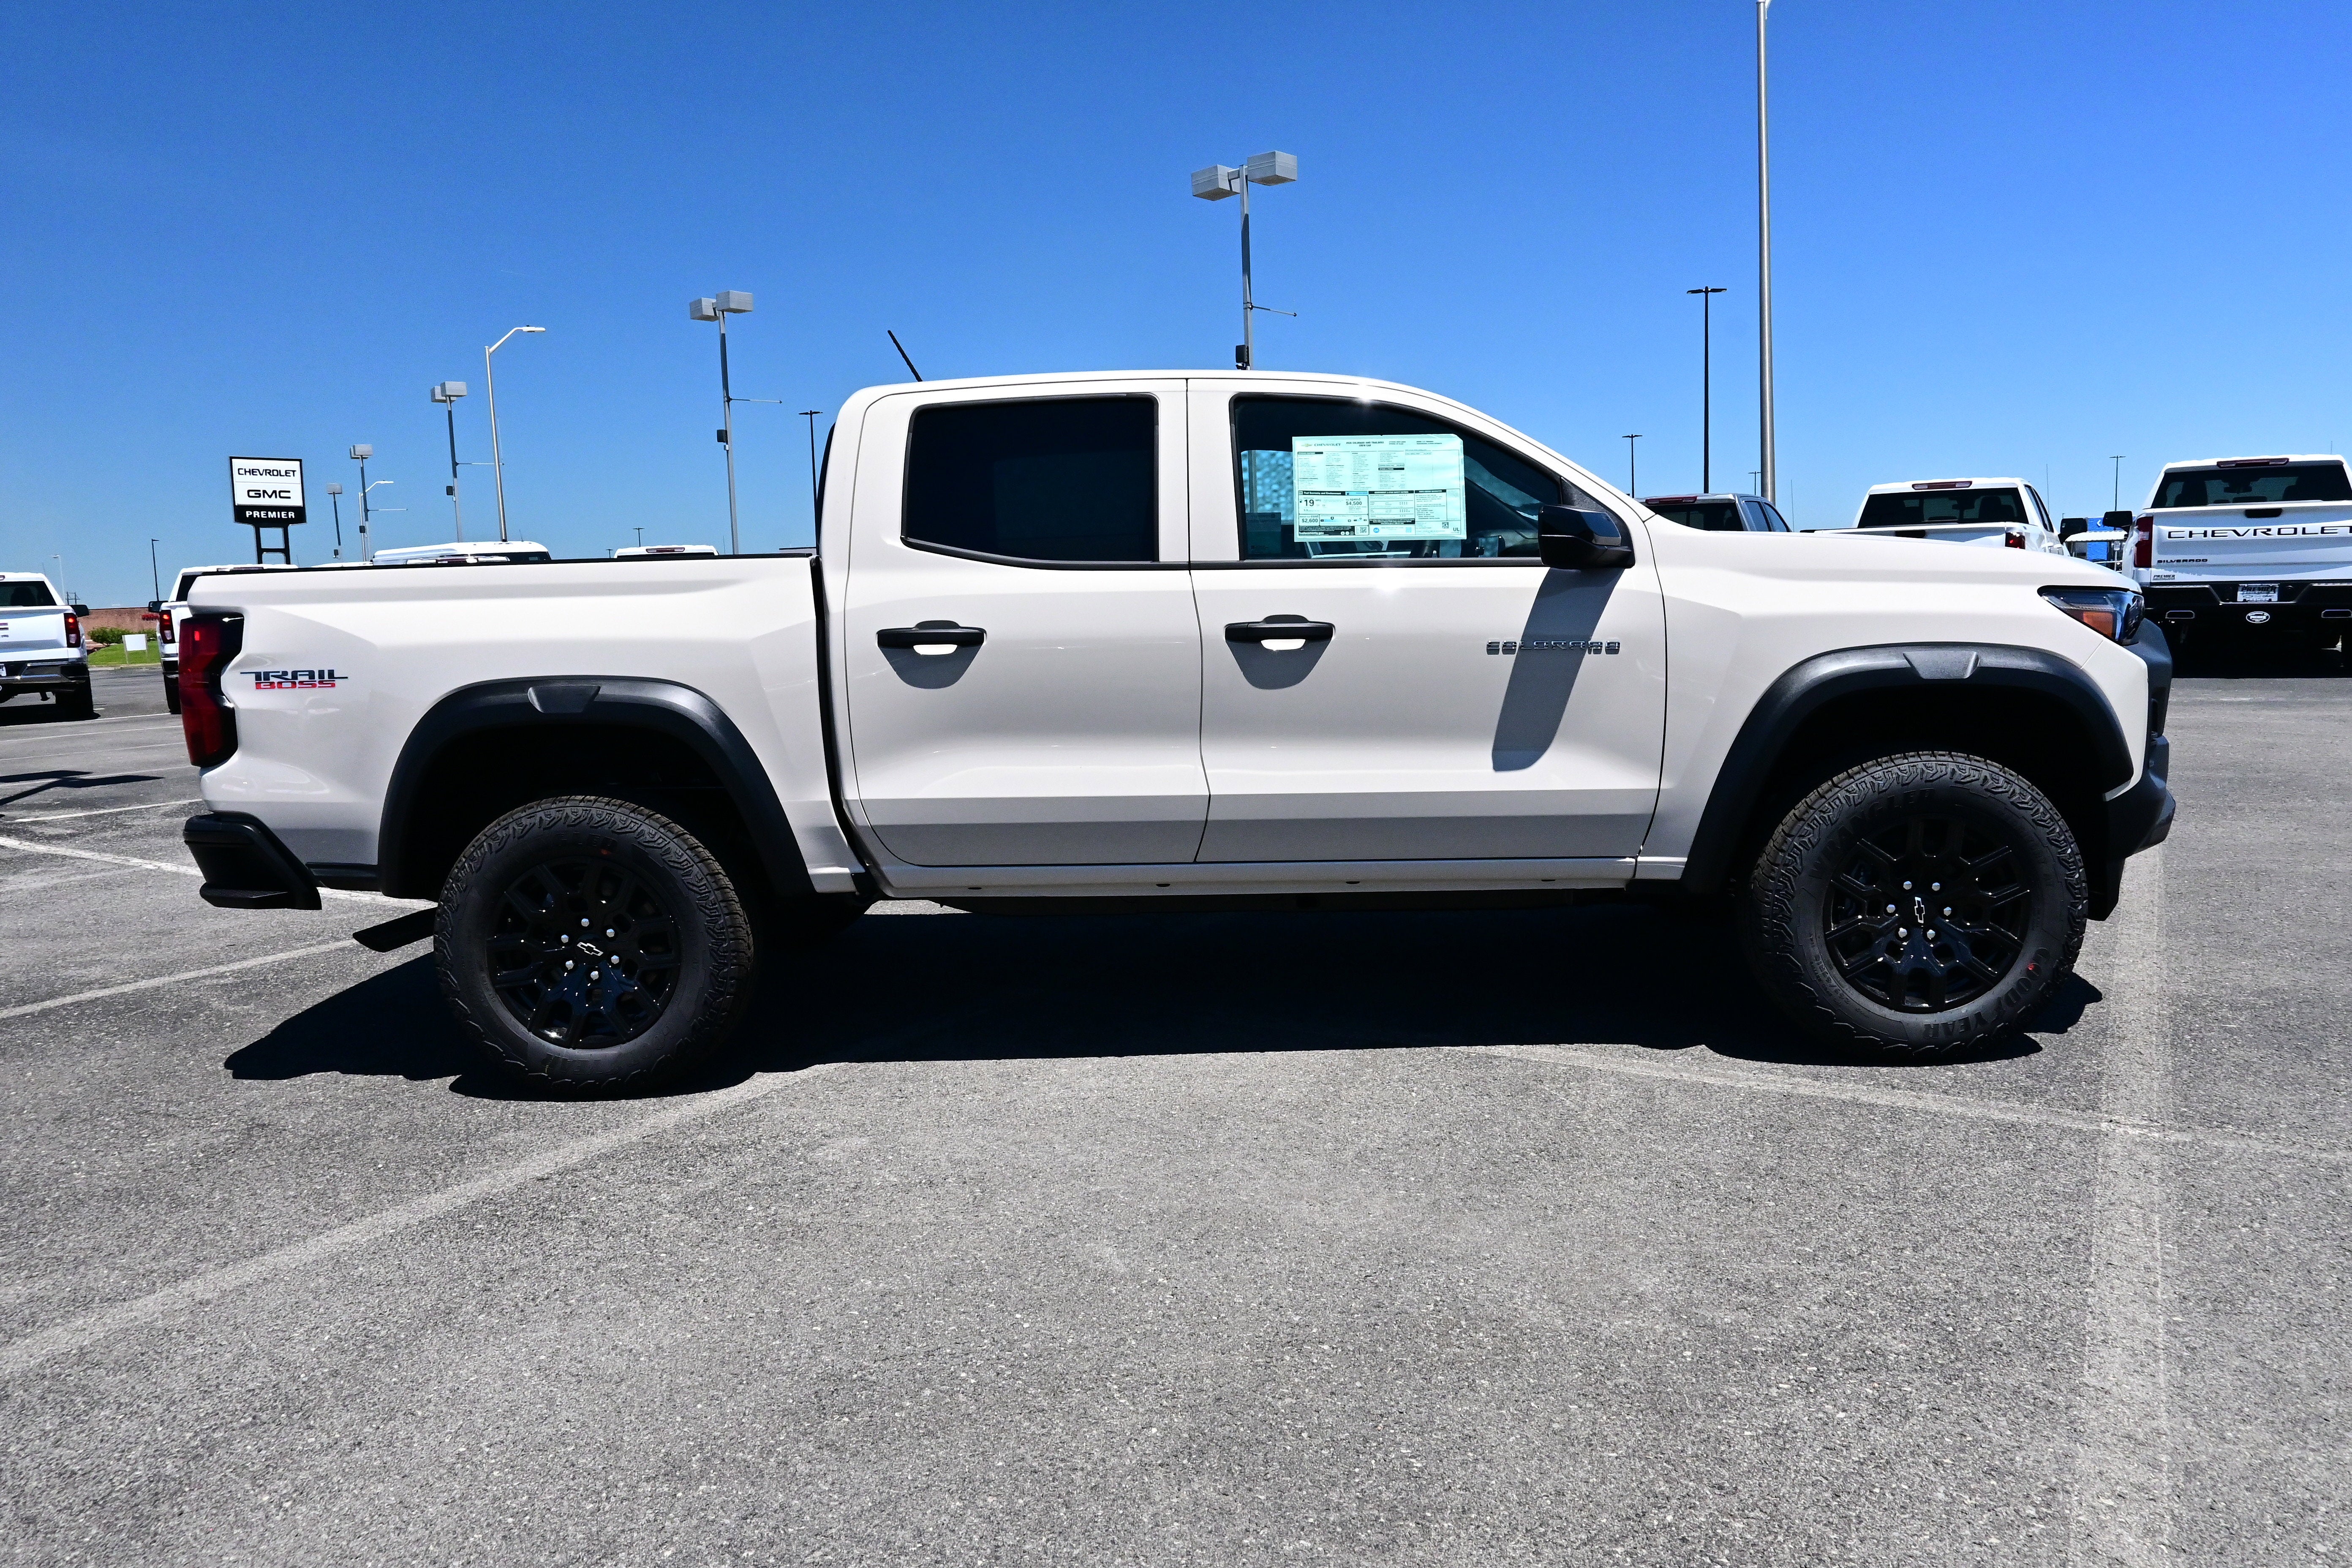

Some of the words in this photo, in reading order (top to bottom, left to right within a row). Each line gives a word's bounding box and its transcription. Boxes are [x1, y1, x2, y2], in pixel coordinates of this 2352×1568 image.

[238, 468, 297, 477] CHEVROLET
[247, 490, 291, 499] GMC
[1486, 640, 1620, 651] COLORADO
[240, 670, 348, 681] TRAIL
[255, 680, 336, 689] BOSS
